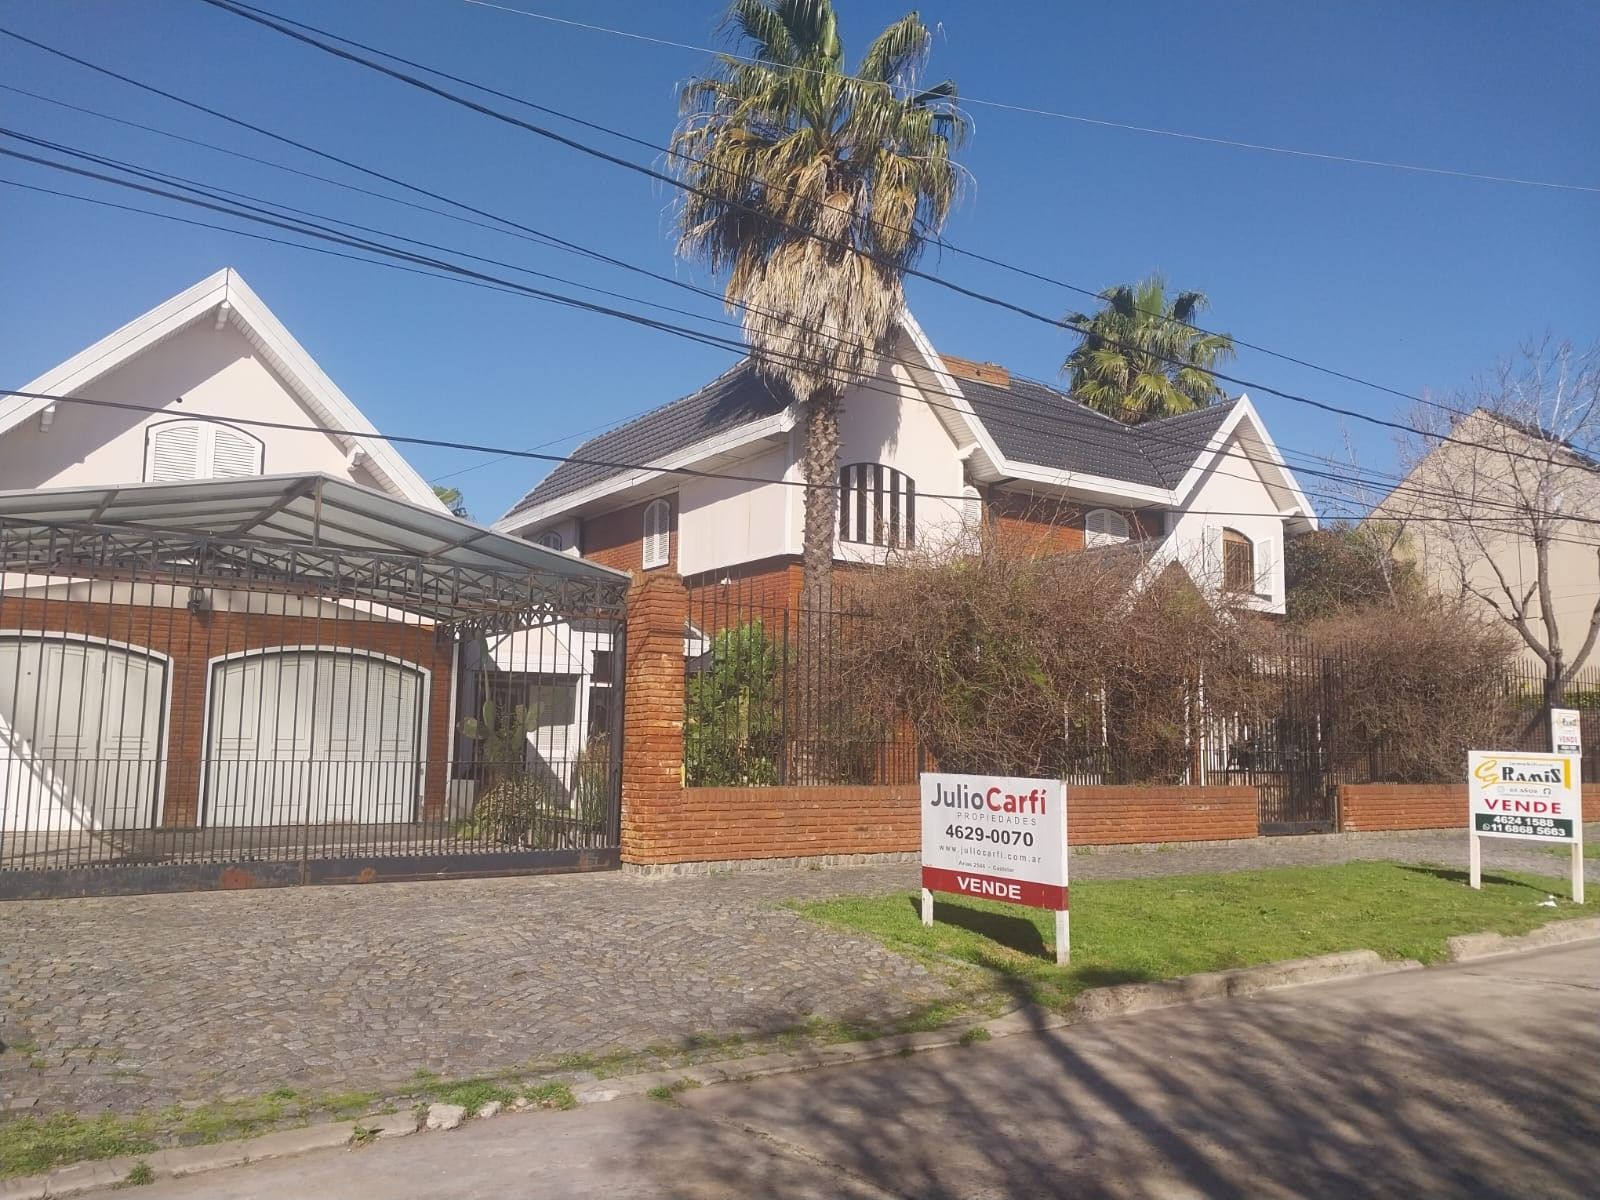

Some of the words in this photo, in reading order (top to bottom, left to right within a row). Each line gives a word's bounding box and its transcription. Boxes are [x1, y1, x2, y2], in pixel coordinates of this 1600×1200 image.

[1484, 798, 1562, 814] VENDE
[957, 812, 1037, 826] PROPIEDADES
[1493, 815, 1522, 825] 4624
[1526, 817, 1554, 827] 1588
[945, 824, 1034, 847] 4629-0070
[1491, 823, 1502, 831] 11
[1504, 825, 1533, 834] 6868
[1536, 826, 1566, 836] 5663
[939, 844, 1042, 863] www.juliocarfi.com.ar
[957, 876, 1022, 900] VENDE
